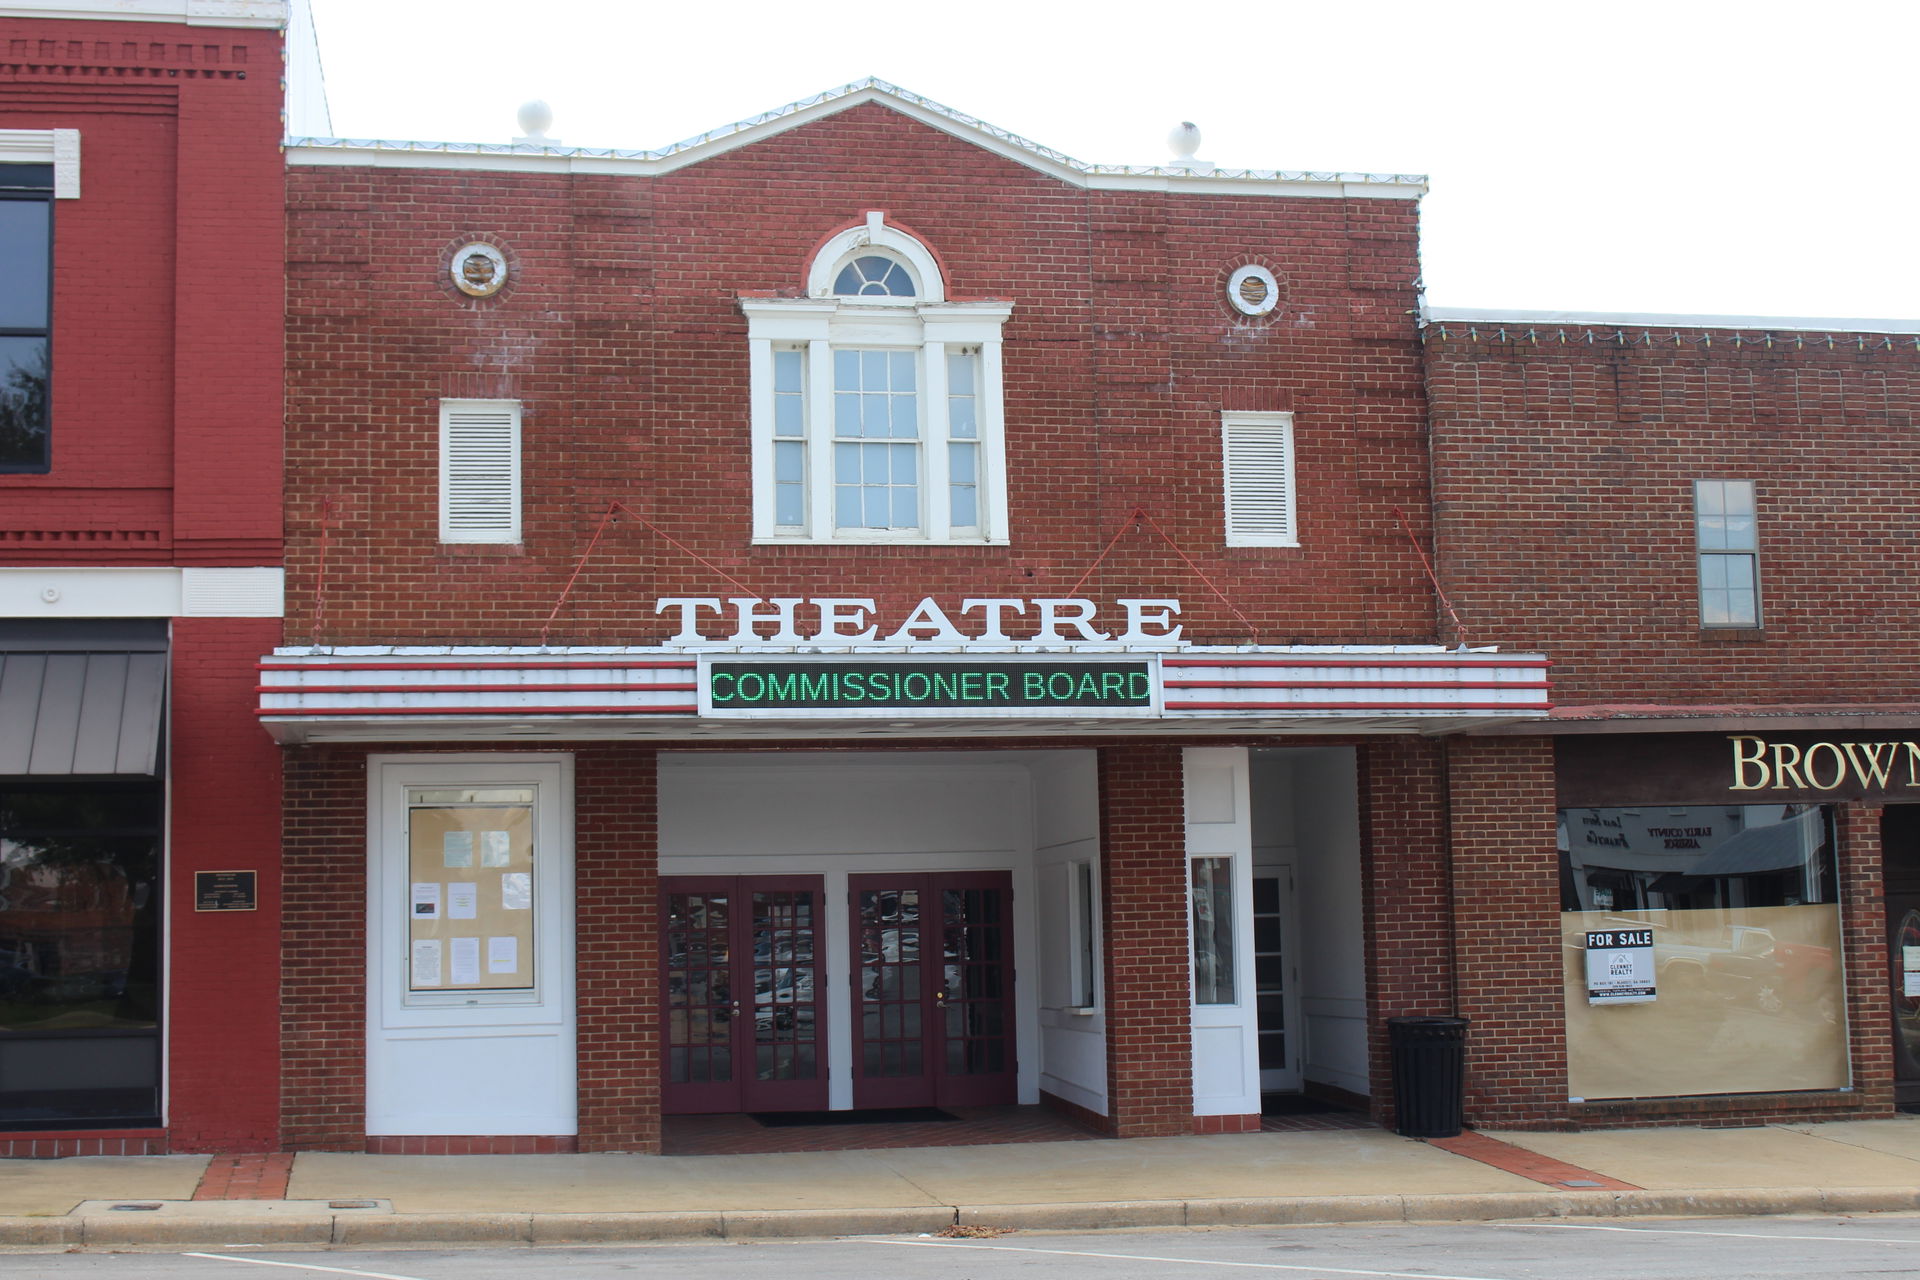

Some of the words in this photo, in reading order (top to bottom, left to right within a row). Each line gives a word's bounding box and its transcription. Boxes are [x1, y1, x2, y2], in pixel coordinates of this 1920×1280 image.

[656, 597, 1183, 641] THEATRE
[711, 672, 1010, 701] COMMISSIONER
[1023, 672, 1151, 700] BOARD
[1588, 934, 1613, 946] FOR
[1619, 932, 1651, 945] SALE
